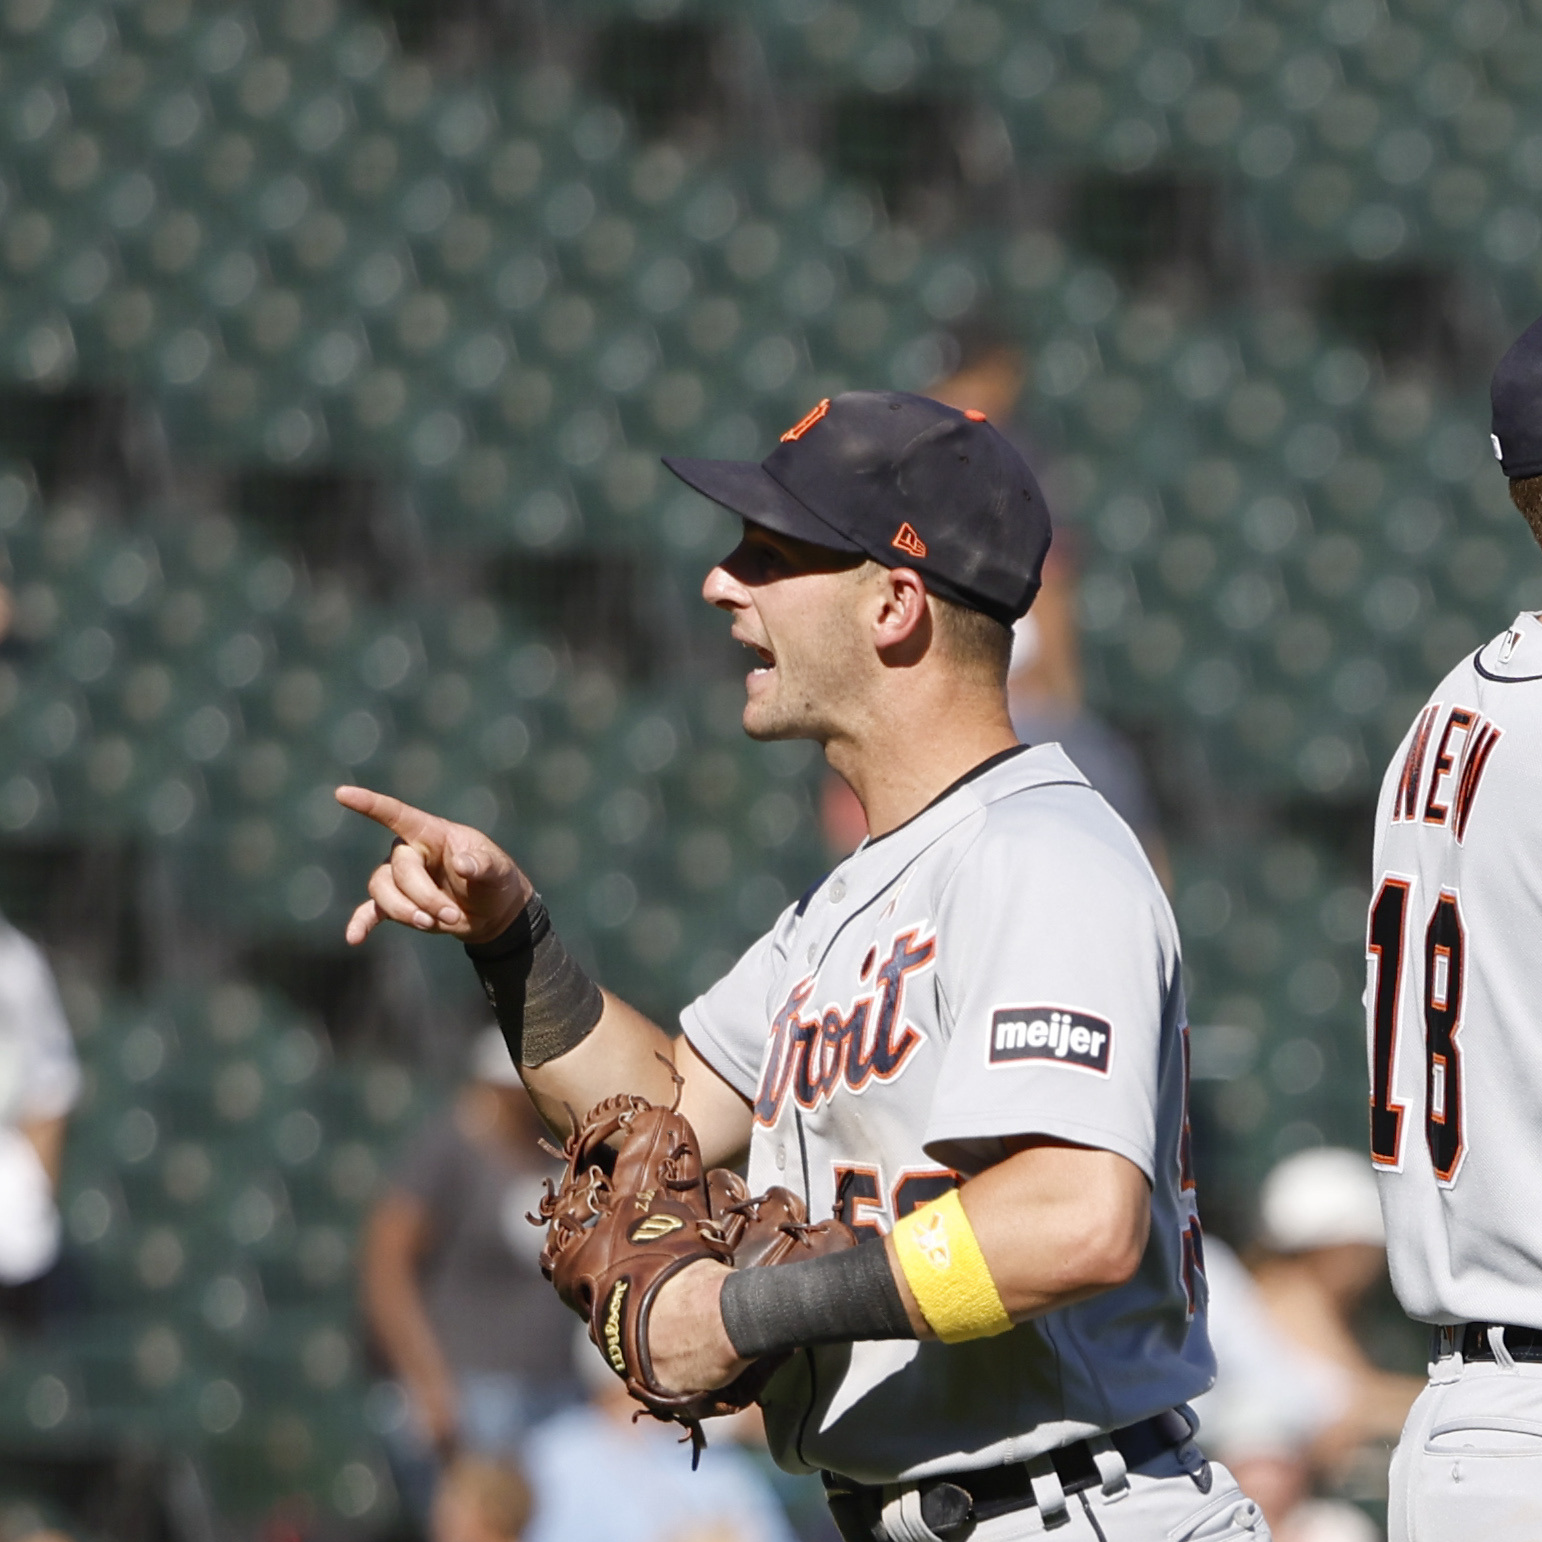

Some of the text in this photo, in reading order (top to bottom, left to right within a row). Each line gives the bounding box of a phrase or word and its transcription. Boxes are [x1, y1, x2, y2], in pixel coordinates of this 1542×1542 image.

[752, 918, 937, 1132] troit
[995, 1012, 1107, 1058] meijer
[1366, 870, 1469, 1190] 18
[604, 1279, 630, 1372] Wilson
